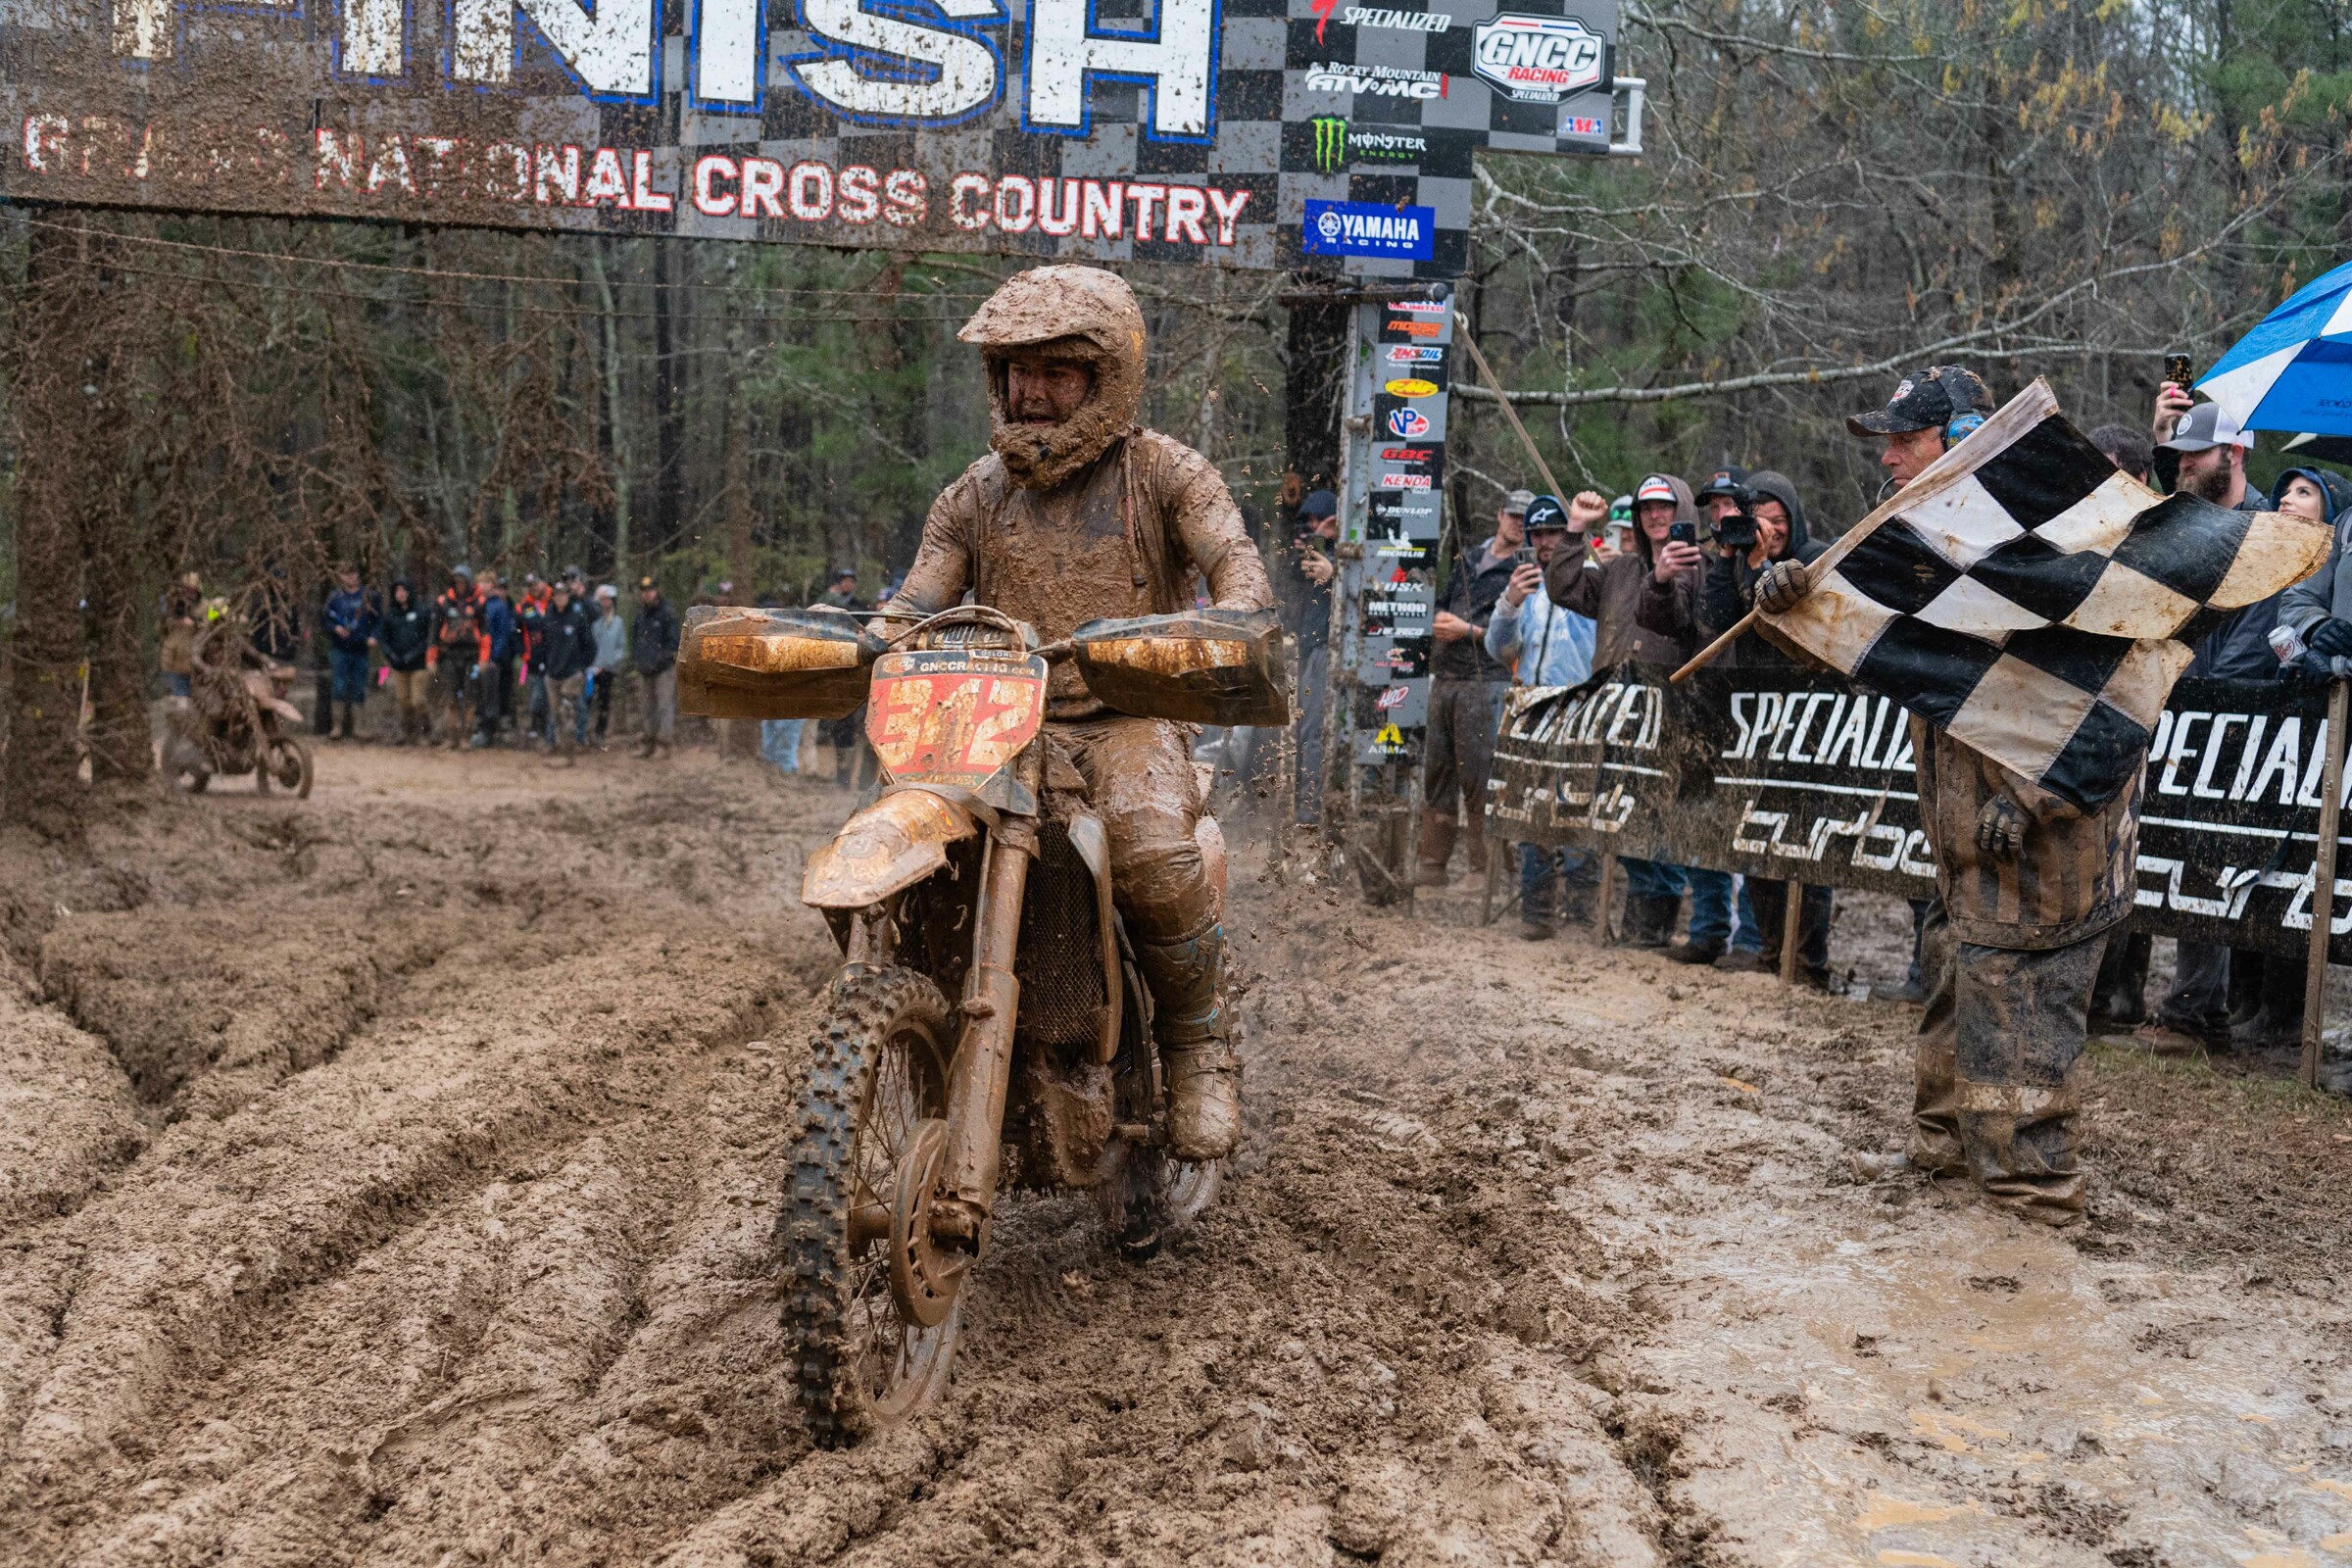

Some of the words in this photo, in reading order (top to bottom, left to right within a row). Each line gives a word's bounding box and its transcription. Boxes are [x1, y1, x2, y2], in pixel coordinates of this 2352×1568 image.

[1339, 6, 1452, 33] SPECIALIZED
[1480, 31, 1597, 72] GNCC
[1371, 65, 1443, 82] MOUNTAIN
[1508, 66, 1570, 84] RACING
[1359, 149, 1415, 160] ENERGY
[315, 127, 673, 212] NATONAL
[693, 153, 927, 225] CROSS
[948, 171, 1250, 246] COUNTRY
[1342, 214, 1420, 241] YAMAHA
[1325, 236, 1414, 249] RACING
[1386, 346, 1443, 362] AMSOIL
[1391, 409, 1417, 435] VP
[1381, 448, 1433, 462] GBC
[1382, 474, 1432, 488] KENDA
[1387, 506, 1433, 515] DUNLOP
[1377, 550, 1426, 559] MICHELIN
[1369, 601, 1427, 612] METHOD
